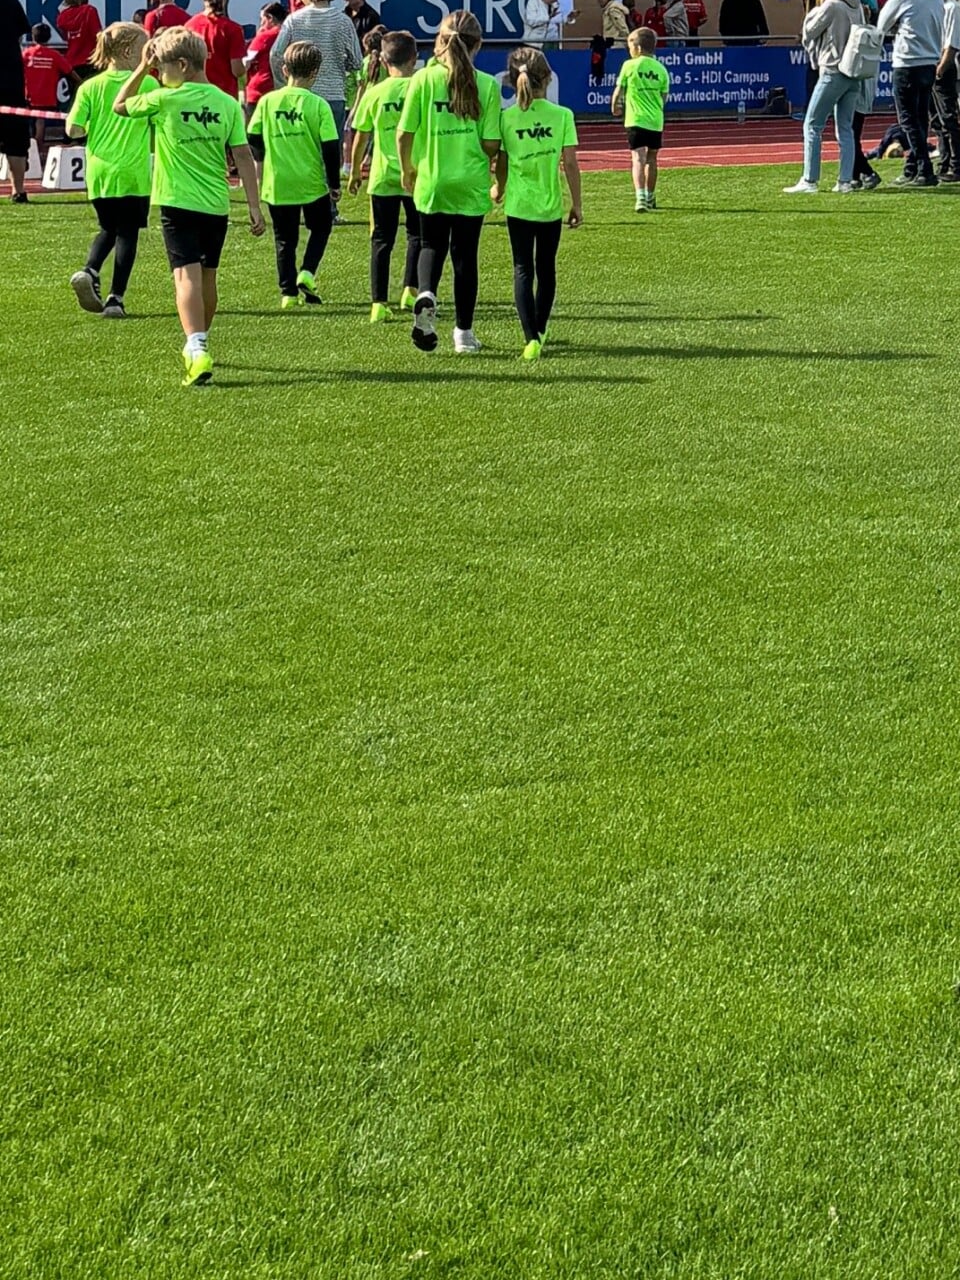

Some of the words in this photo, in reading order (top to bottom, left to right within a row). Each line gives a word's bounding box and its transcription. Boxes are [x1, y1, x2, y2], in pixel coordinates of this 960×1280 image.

[685, 51, 723, 65] GmbH
[685, 72, 692, 84] 5
[702, 71, 721, 84] HDI
[724, 72, 769, 86] Campus
[181, 108, 221, 127] TVK
[515, 126, 552, 141] TVK
[71, 157, 84, 182] 2
